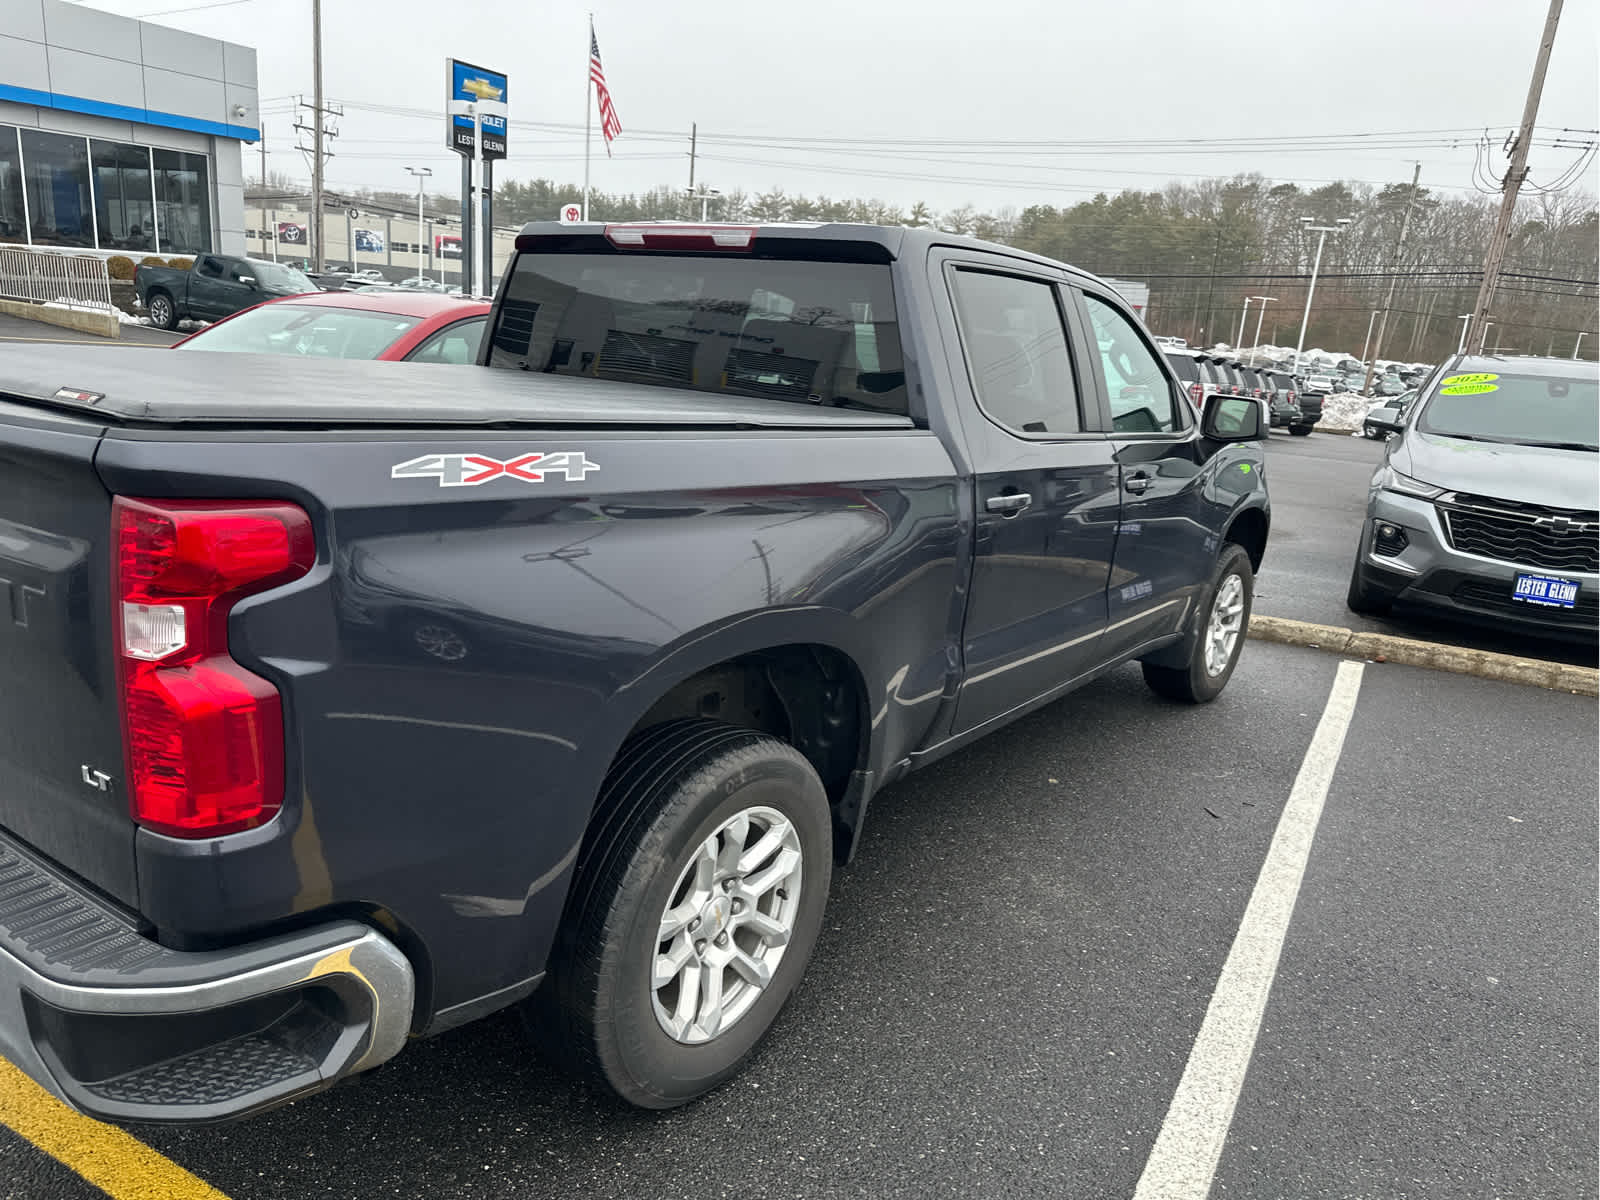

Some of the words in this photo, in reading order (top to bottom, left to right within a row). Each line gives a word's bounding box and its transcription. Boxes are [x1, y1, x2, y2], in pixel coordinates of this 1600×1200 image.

[458, 134, 475, 146] LEST
[483, 140, 504, 153] GLENN
[1516, 577, 1547, 596] LESTER
[1549, 583, 1577, 601] GLENN
[81, 765, 111, 791] LT
